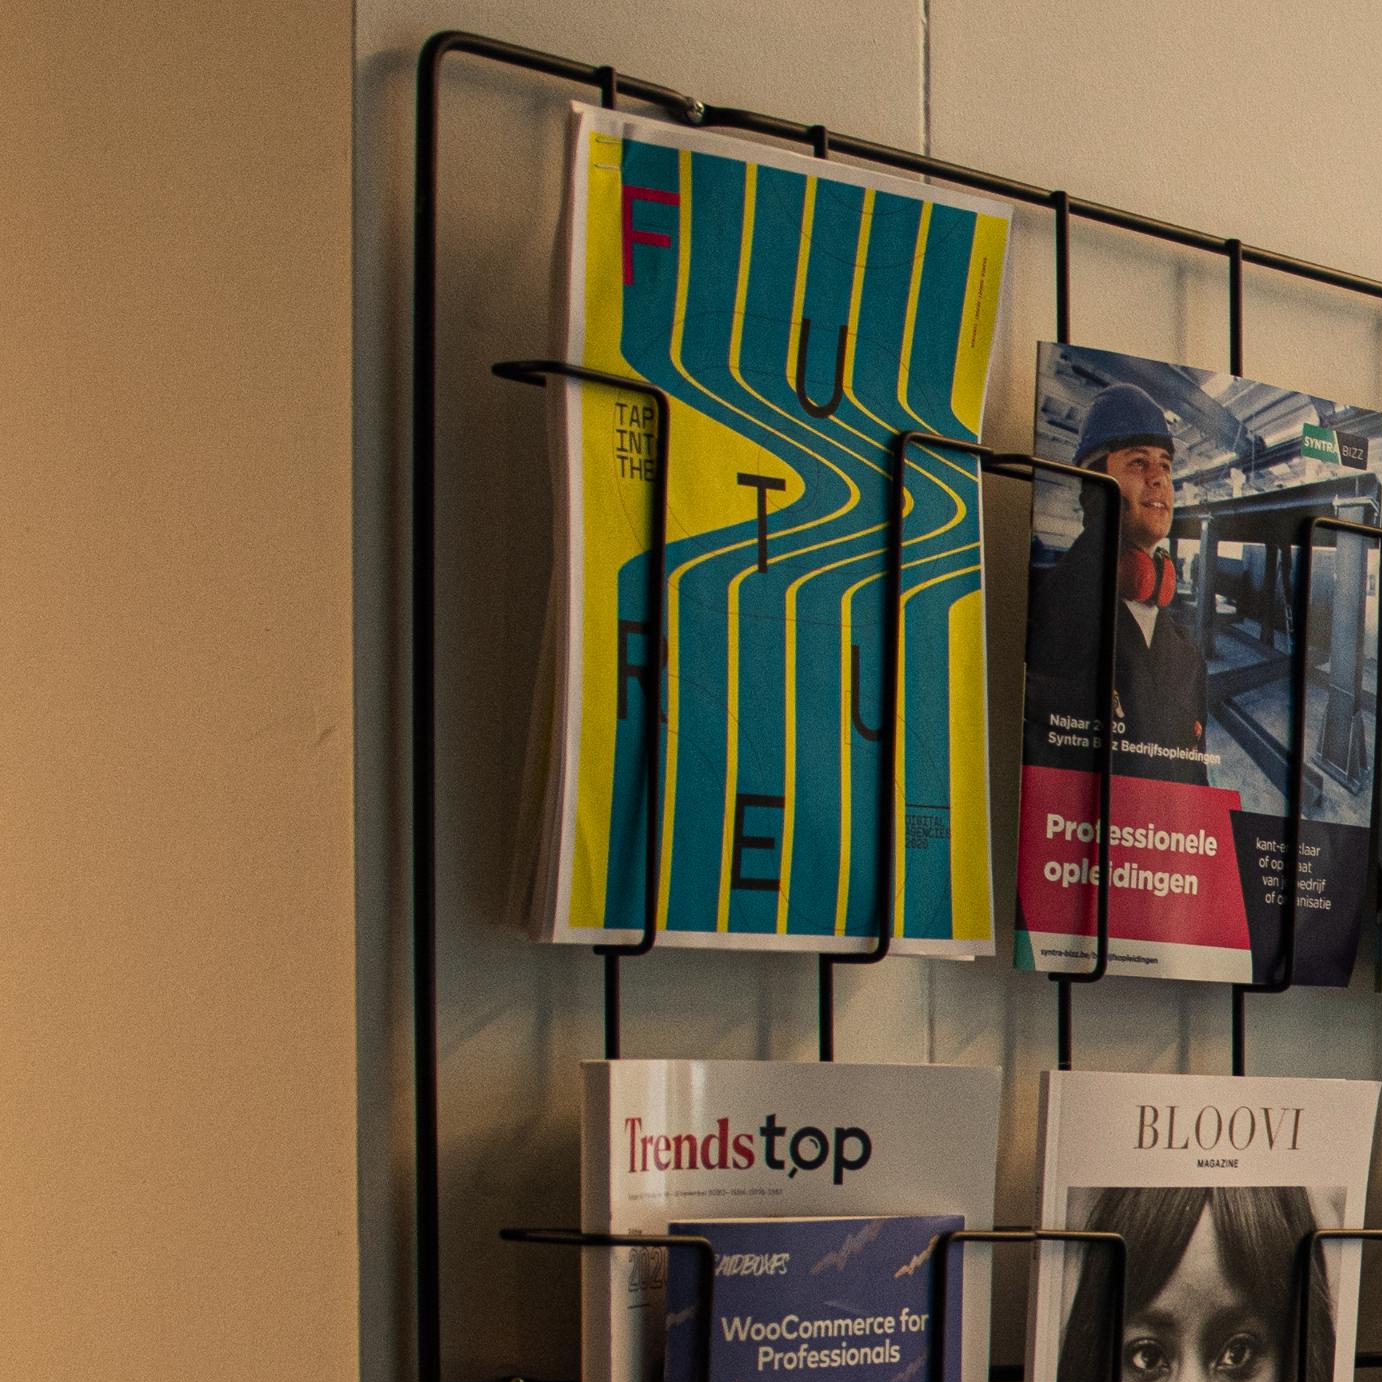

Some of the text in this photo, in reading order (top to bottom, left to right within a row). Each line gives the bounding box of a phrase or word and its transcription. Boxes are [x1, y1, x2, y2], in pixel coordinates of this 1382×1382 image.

[615, 402, 656, 430] TAP
[1303, 436, 1364, 461] SYNTRA BIZZ
[616, 455, 657, 482] THE
[1050, 713, 1126, 735] Najaar 220
[1048, 731, 1222, 766] Syntra Bedrijfsopleidingen
[1259, 855, 1270, 869] of
[1262, 876, 1279, 887] van
[1265, 891, 1276, 905] of
[1133, 1104, 1305, 1151] BLOOVI
[1196, 1158, 1239, 1170] MAGAZINE
[721, 1307, 930, 1342] WooCommerce for
[757, 1339, 901, 1371] Professionals
